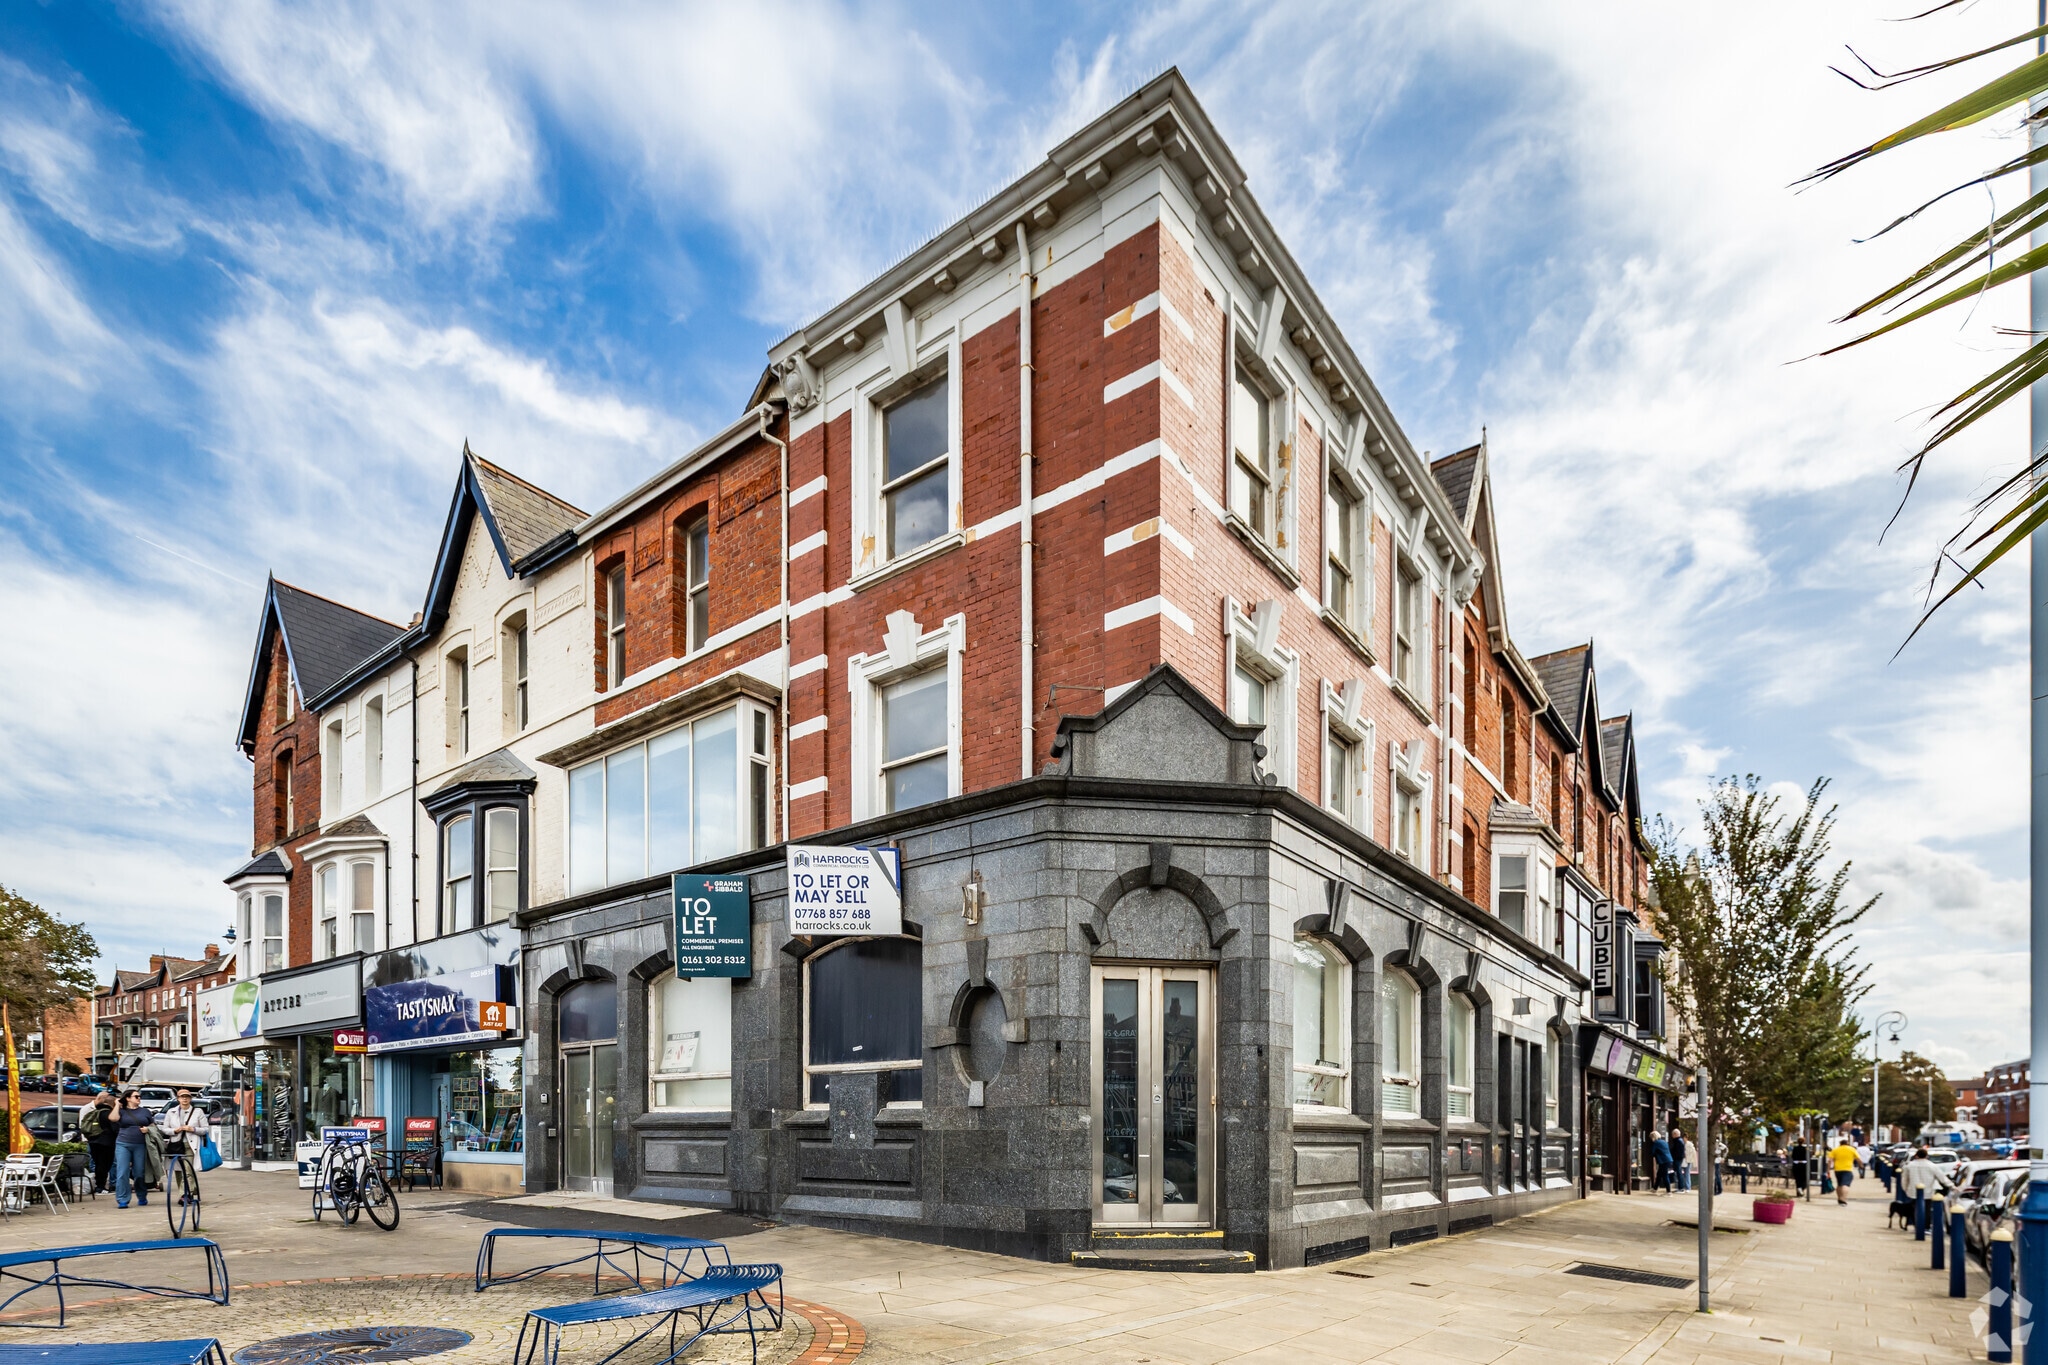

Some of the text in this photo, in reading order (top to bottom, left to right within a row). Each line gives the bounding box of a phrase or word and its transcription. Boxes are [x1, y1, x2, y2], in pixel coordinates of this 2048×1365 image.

[812, 855, 869, 864] HARROCKS
[793, 874, 870, 889] TO LET OR
[794, 889, 867, 904] MAY SELL
[681, 897, 711, 916] TO
[794, 908, 871, 919] 07768 857 688
[682, 916, 718, 935] LET
[795, 920, 871, 931] harrocks.co.uk
[1594, 903, 1609, 986] CUBE
[682, 956, 746, 964] 0161 302 5312
[264, 994, 302, 1013] ATTIRE
[396, 994, 456, 1021] TASTYSNAX
[409, 1120, 432, 1128] Coca-Cola
